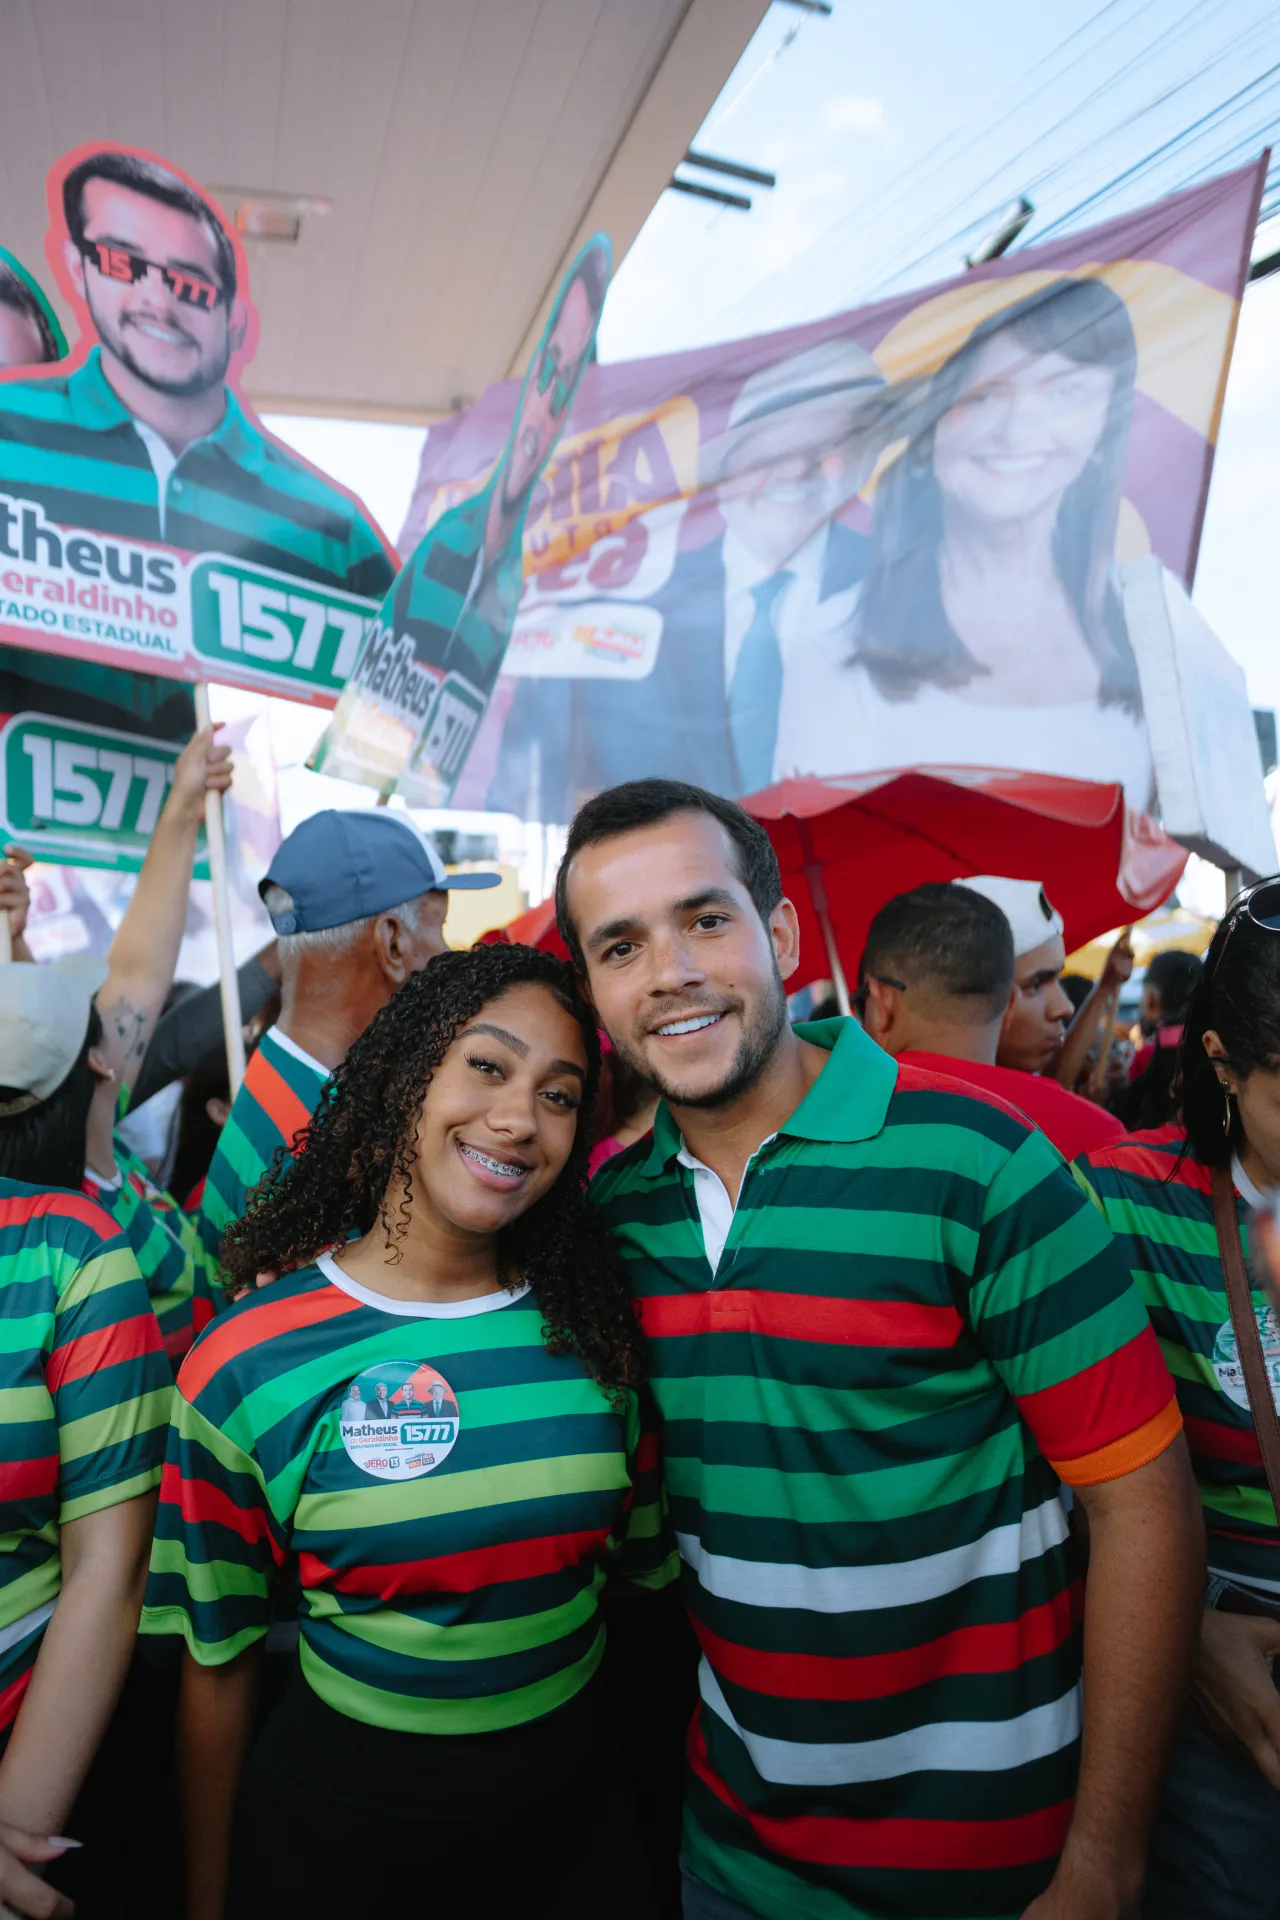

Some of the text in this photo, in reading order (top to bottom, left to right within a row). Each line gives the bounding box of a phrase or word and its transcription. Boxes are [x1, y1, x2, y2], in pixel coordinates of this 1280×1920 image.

[96, 243, 217, 308] 15 777
[0, 502, 177, 595] theus
[63, 613, 178, 653] ESTADUAL
[208, 571, 376, 679] 1577
[354, 627, 436, 719] Matheus
[22, 734, 175, 834] 1577
[343, 1424, 398, 1437] Matheus
[359, 1435, 398, 1443] Geraldinho
[404, 1424, 450, 1441] 15777
[366, 1459, 388, 1468] JERO
